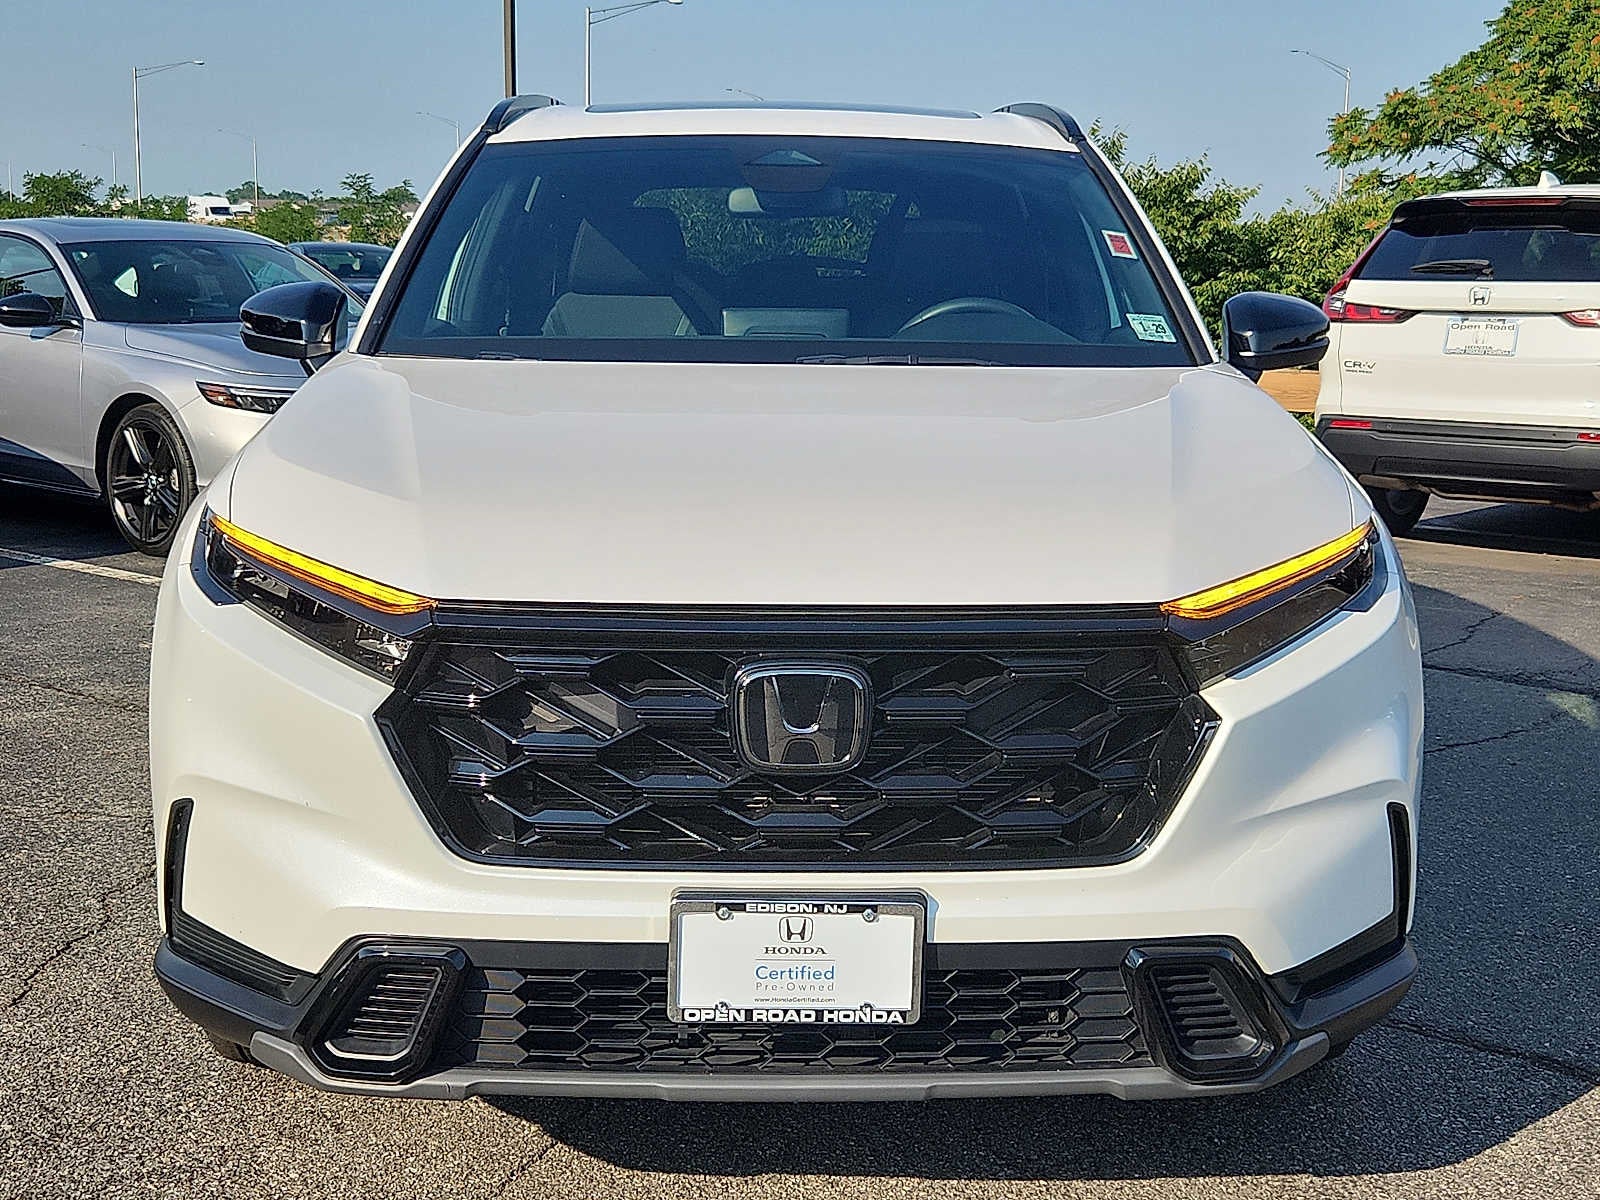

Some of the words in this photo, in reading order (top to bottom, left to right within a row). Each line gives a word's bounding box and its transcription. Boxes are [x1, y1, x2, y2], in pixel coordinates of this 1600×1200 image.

[1152, 323, 1166, 334] 29
[1451, 323, 1481, 331] Open
[1485, 323, 1515, 331] Road
[745, 903, 818, 914] EDISON,
[823, 903, 848, 914] NJ
[764, 946, 827, 955] HONDA
[755, 965, 835, 981] Certified
[756, 982, 835, 992] Pre-Owned
[754, 996, 836, 1004] www.HondaCertified.com
[683, 1008, 746, 1022] OPEN
[752, 1009, 816, 1023] ROAD
[823, 1010, 904, 1023] HONDA
